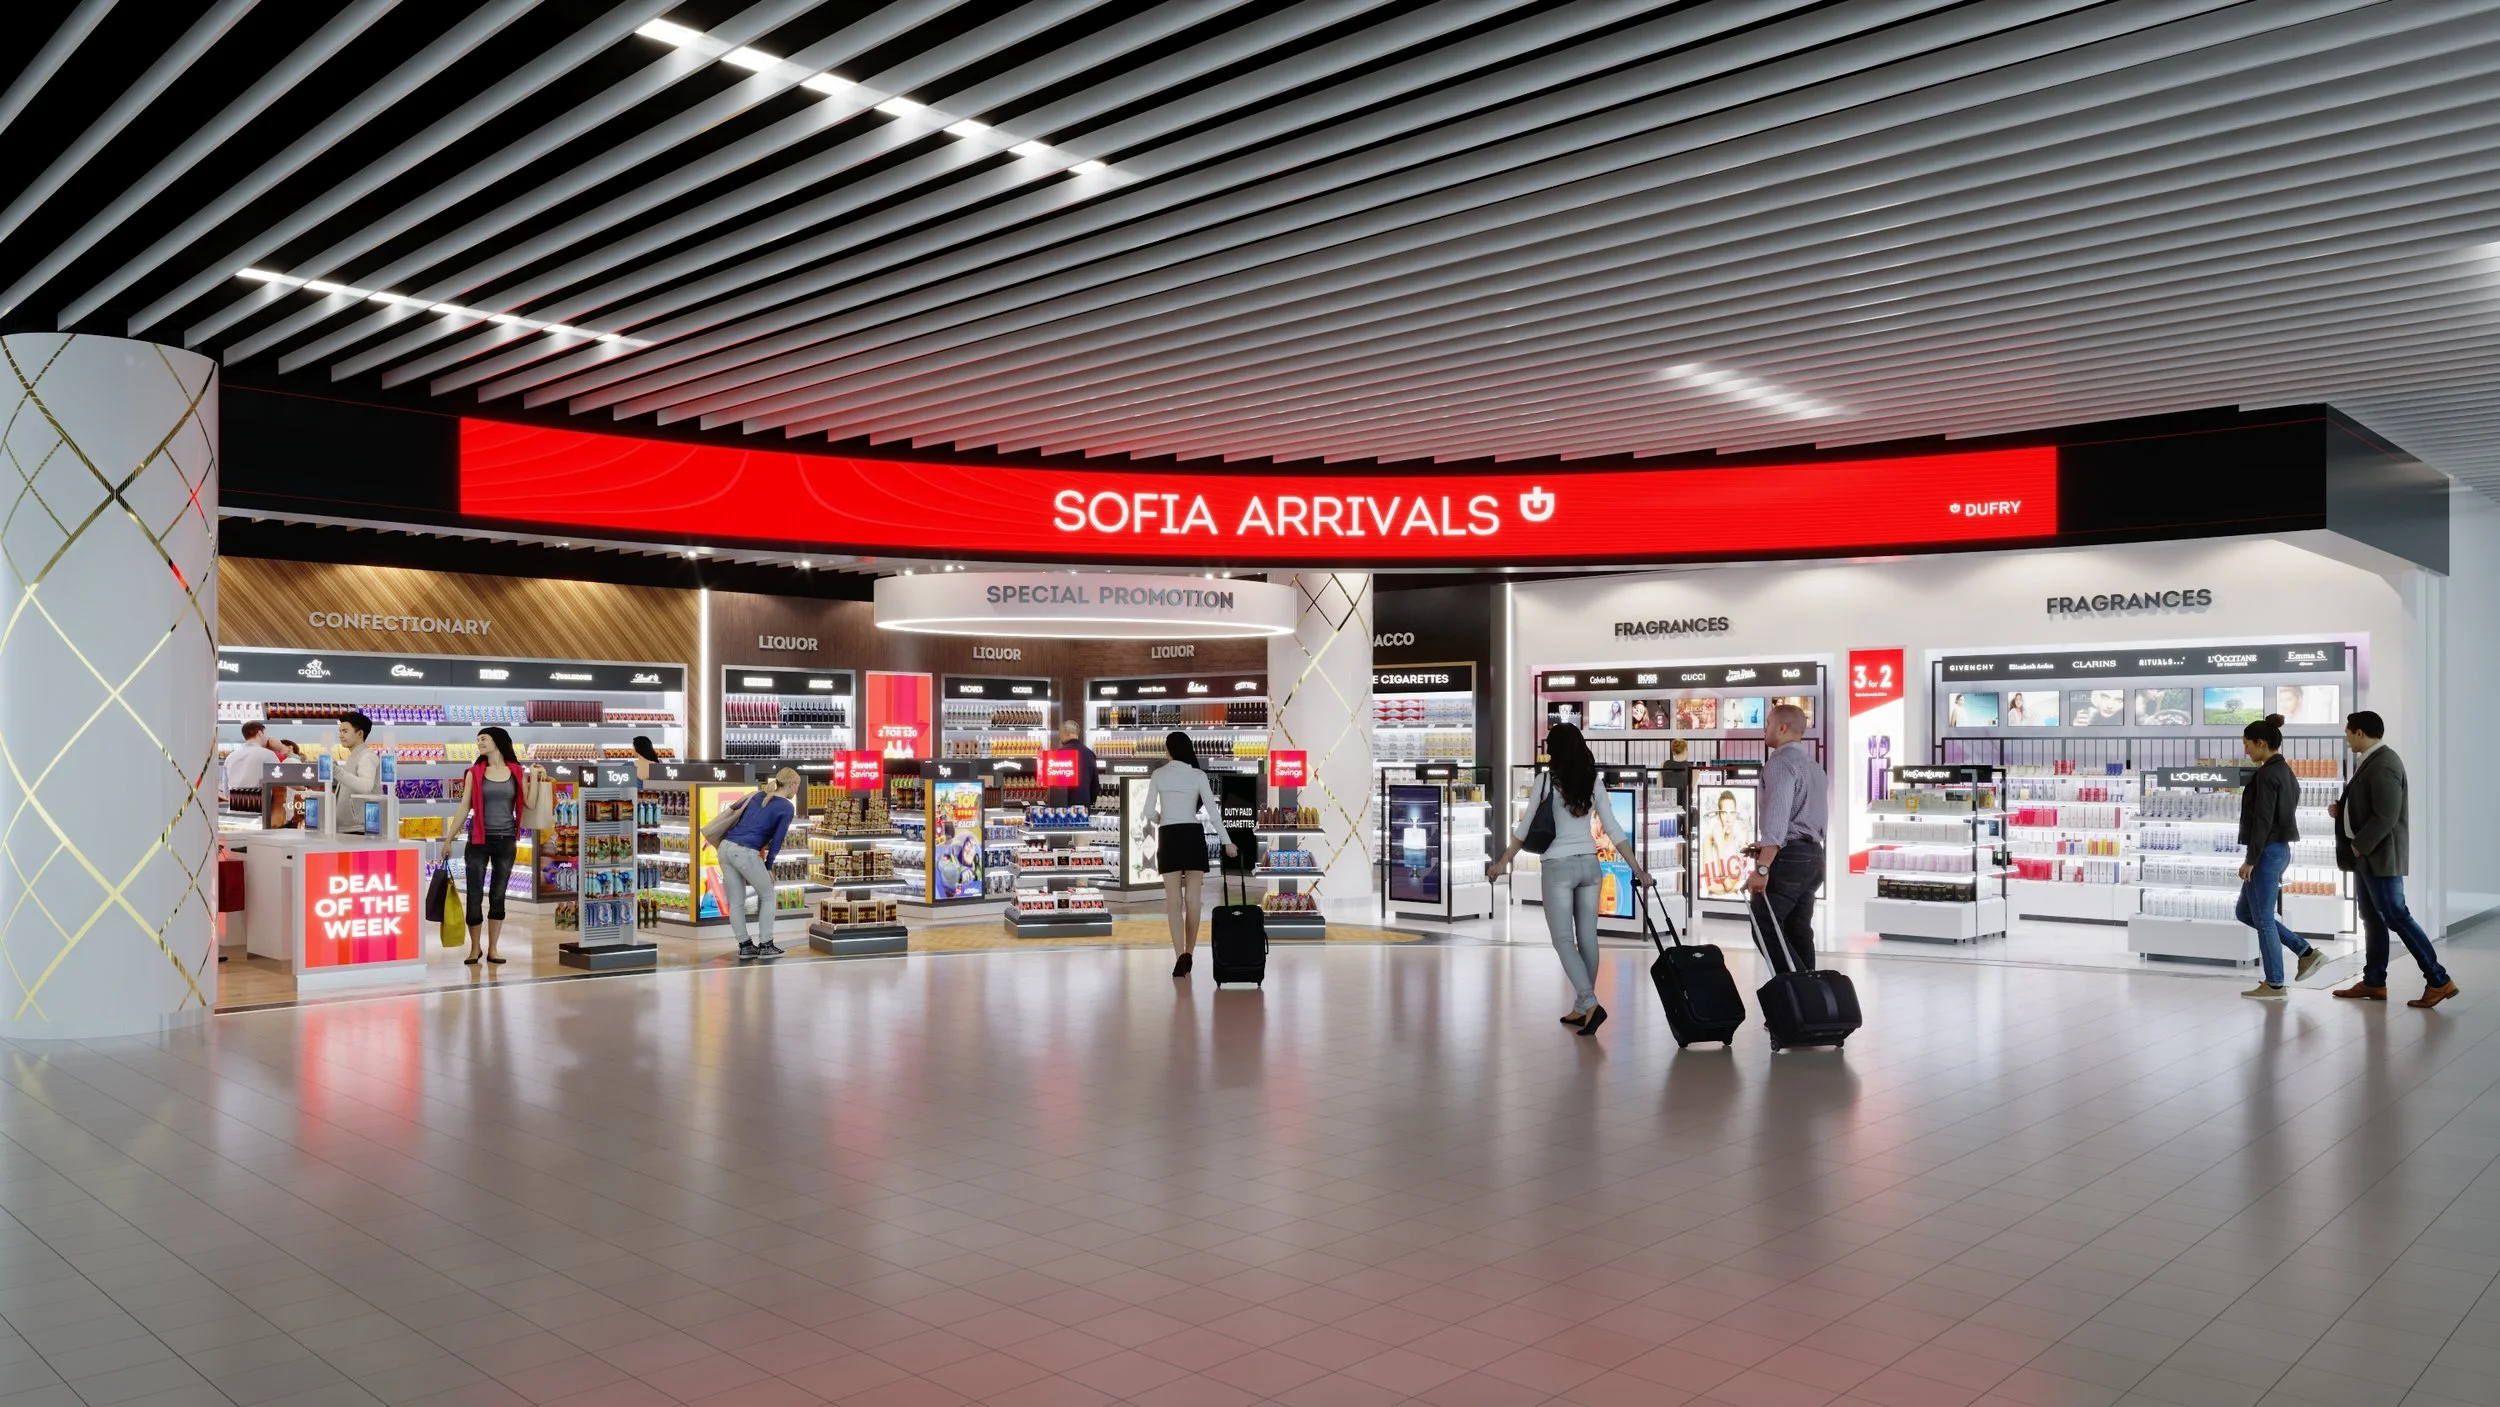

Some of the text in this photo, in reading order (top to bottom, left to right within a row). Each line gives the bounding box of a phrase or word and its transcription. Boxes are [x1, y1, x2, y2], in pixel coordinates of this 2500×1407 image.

[1053, 488, 1501, 538] SOFIA ARRIVALS
[1965, 500, 2022, 516] DUFRY
[986, 585, 1235, 610] SPECIAL PROMOTION
[2046, 588, 2213, 615] FRAGRANCES
[308, 611, 492, 636] CONFECTIONARY
[1614, 616, 1730, 637] FRAGRANCES
[758, 634, 819, 651] LIQUOR
[1372, 632, 1415, 648] ACCO
[973, 646, 1022, 661] LIQUOR
[1151, 644, 1195, 659] LIQUOR
[2287, 650, 2327, 660] Emma S.
[2072, 659, 2117, 669] CLARINS
[2207, 654, 2258, 664] L'OCCITANE
[1949, 663, 1994, 672] GIVENCHY
[2036, 662, 2054, 670] Arden
[298, 668, 331, 677] GODIVA
[1637, 674, 1658, 682] BOSS
[1681, 673, 1706, 681] GUCCI
[1781, 668, 1801, 678] D&G
[1853, 664, 1893, 690] 3 for 2
[1380, 673, 1449, 685] CIGARETTES
[1589, 674, 1619, 684] Calvin Klein
[878, 729, 918, 737] 2 FOR $20
[850, 760, 878, 769] Sweet
[1047, 759, 1073, 768] Sweet
[1275, 759, 1302, 769] Sweet
[583, 769, 595, 785] Toys
[607, 770, 630, 785] Toys
[665, 766, 678, 780] Toys
[713, 767, 726, 781] Toys
[850, 769, 879, 779] Savings
[938, 765, 952, 778] Toys
[1047, 767, 1075, 778] Savings
[1275, 767, 1303, 778] Savings
[2170, 772, 2228, 782] L'ORÉAL
[955, 791, 979, 808] TOY
[1224, 807, 1253, 817] DUTY PAID
[1222, 819, 1256, 829] CIGARETTES
[328, 873, 399, 896] DEAL
[314, 894, 410, 919] OF THE
[323, 917, 402, 940] WEEK
